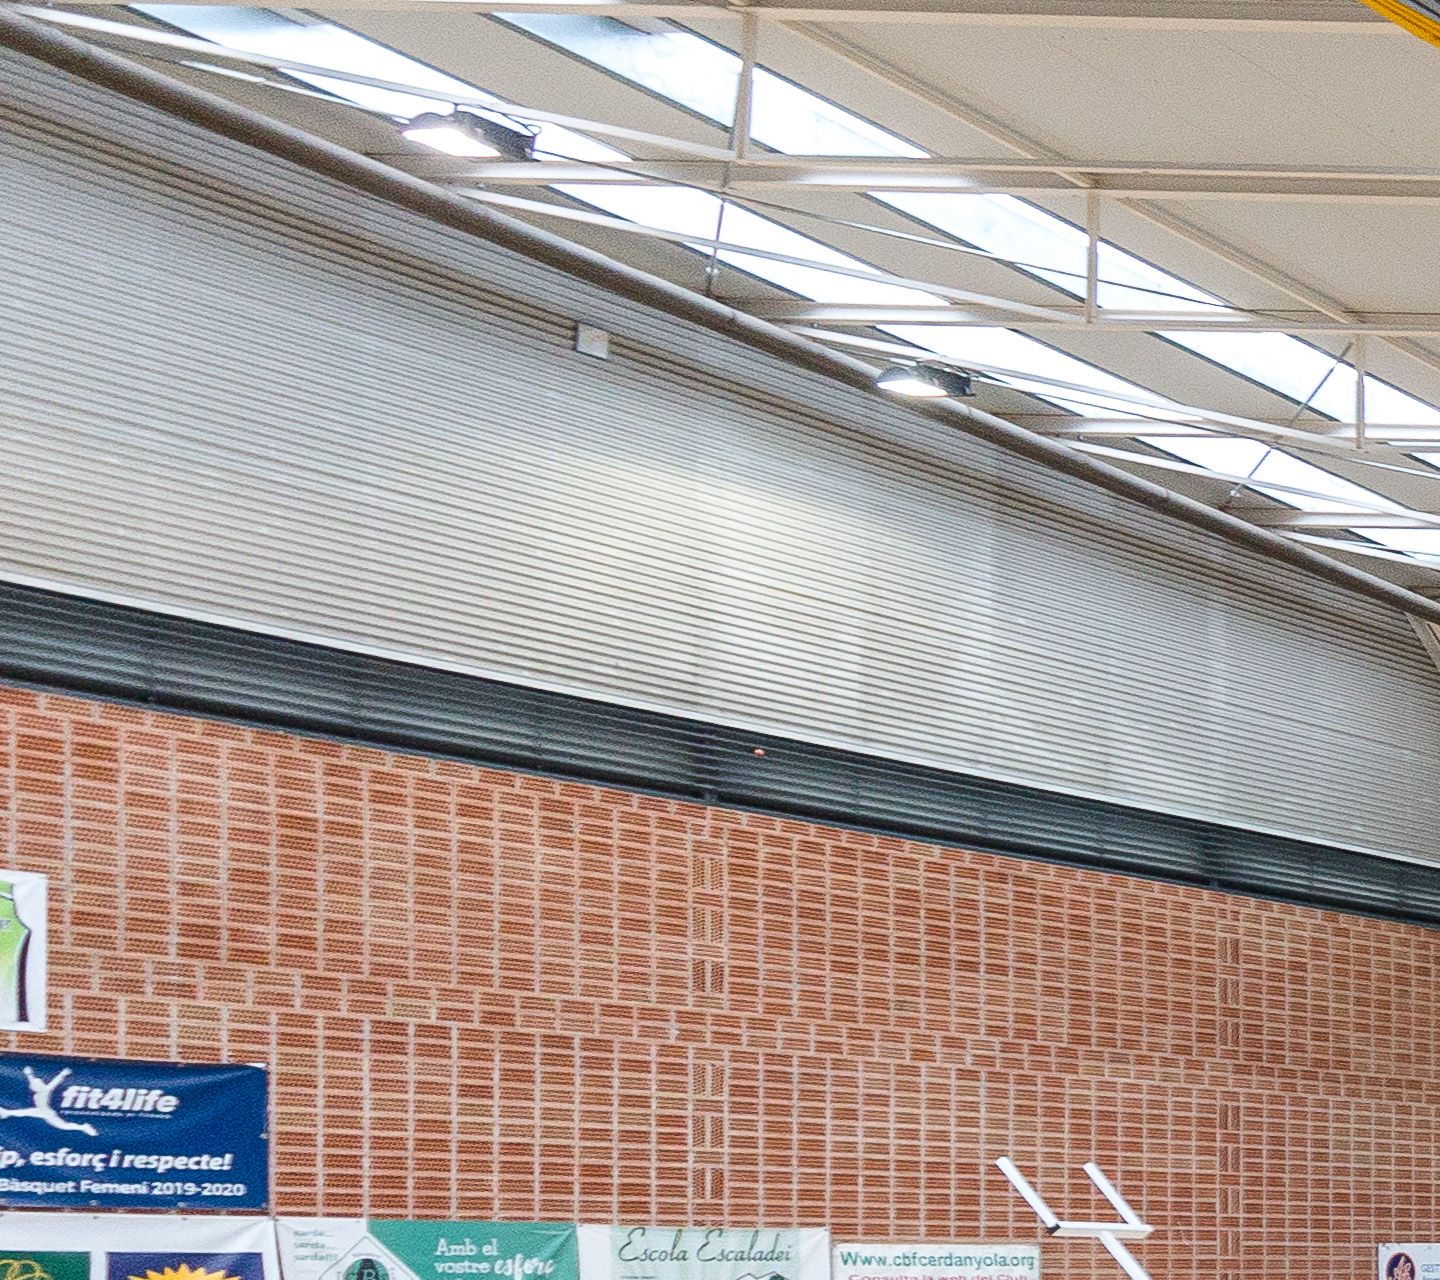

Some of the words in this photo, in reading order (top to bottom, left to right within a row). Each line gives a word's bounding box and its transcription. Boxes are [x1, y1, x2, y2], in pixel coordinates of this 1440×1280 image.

[60, 1085, 180, 1113] fit4life
[29, 1147, 108, 1172] esforç
[109, 1149, 123, 1168] i
[123, 1152, 234, 1173] respecte!
[151, 1182, 247, 1196] 2019-2020
[435, 1238, 479, 1256] Amb
[482, 1238, 497, 1256] el
[618, 1227, 688, 1262] Escola
[697, 1228, 792, 1262] Escaladei
[434, 1260, 490, 1273] vostre
